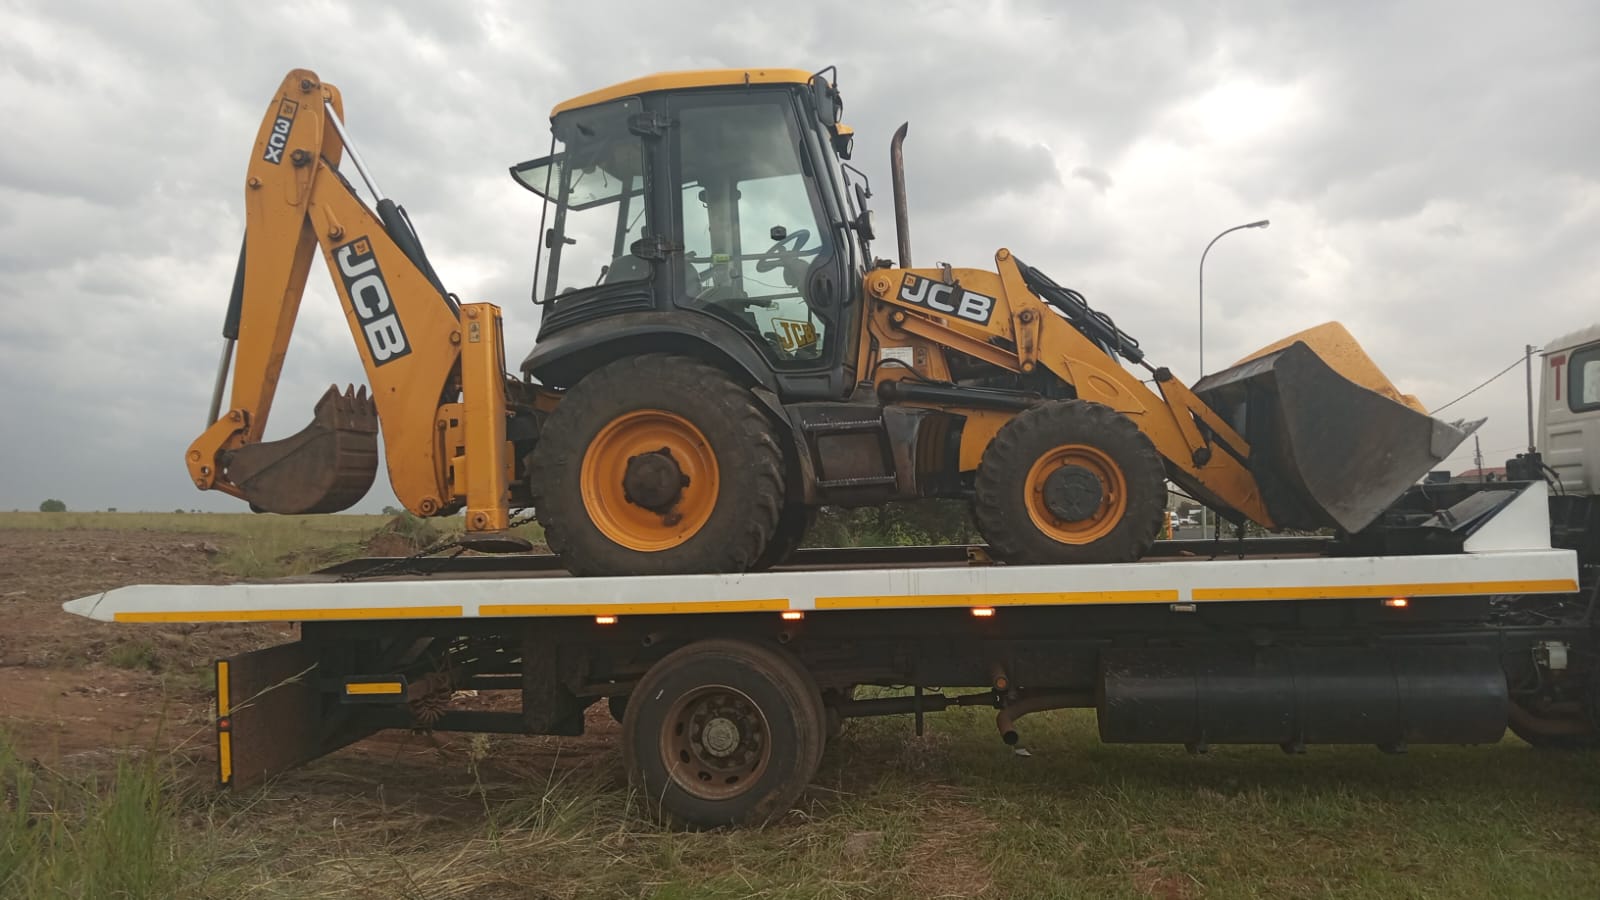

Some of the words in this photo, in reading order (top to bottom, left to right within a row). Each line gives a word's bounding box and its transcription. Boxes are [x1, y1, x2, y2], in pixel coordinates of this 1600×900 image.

[265, 118, 290, 163] 3CX
[338, 246, 405, 361] JCB
[901, 279, 991, 322] JCB
[780, 321, 817, 350] JCB
